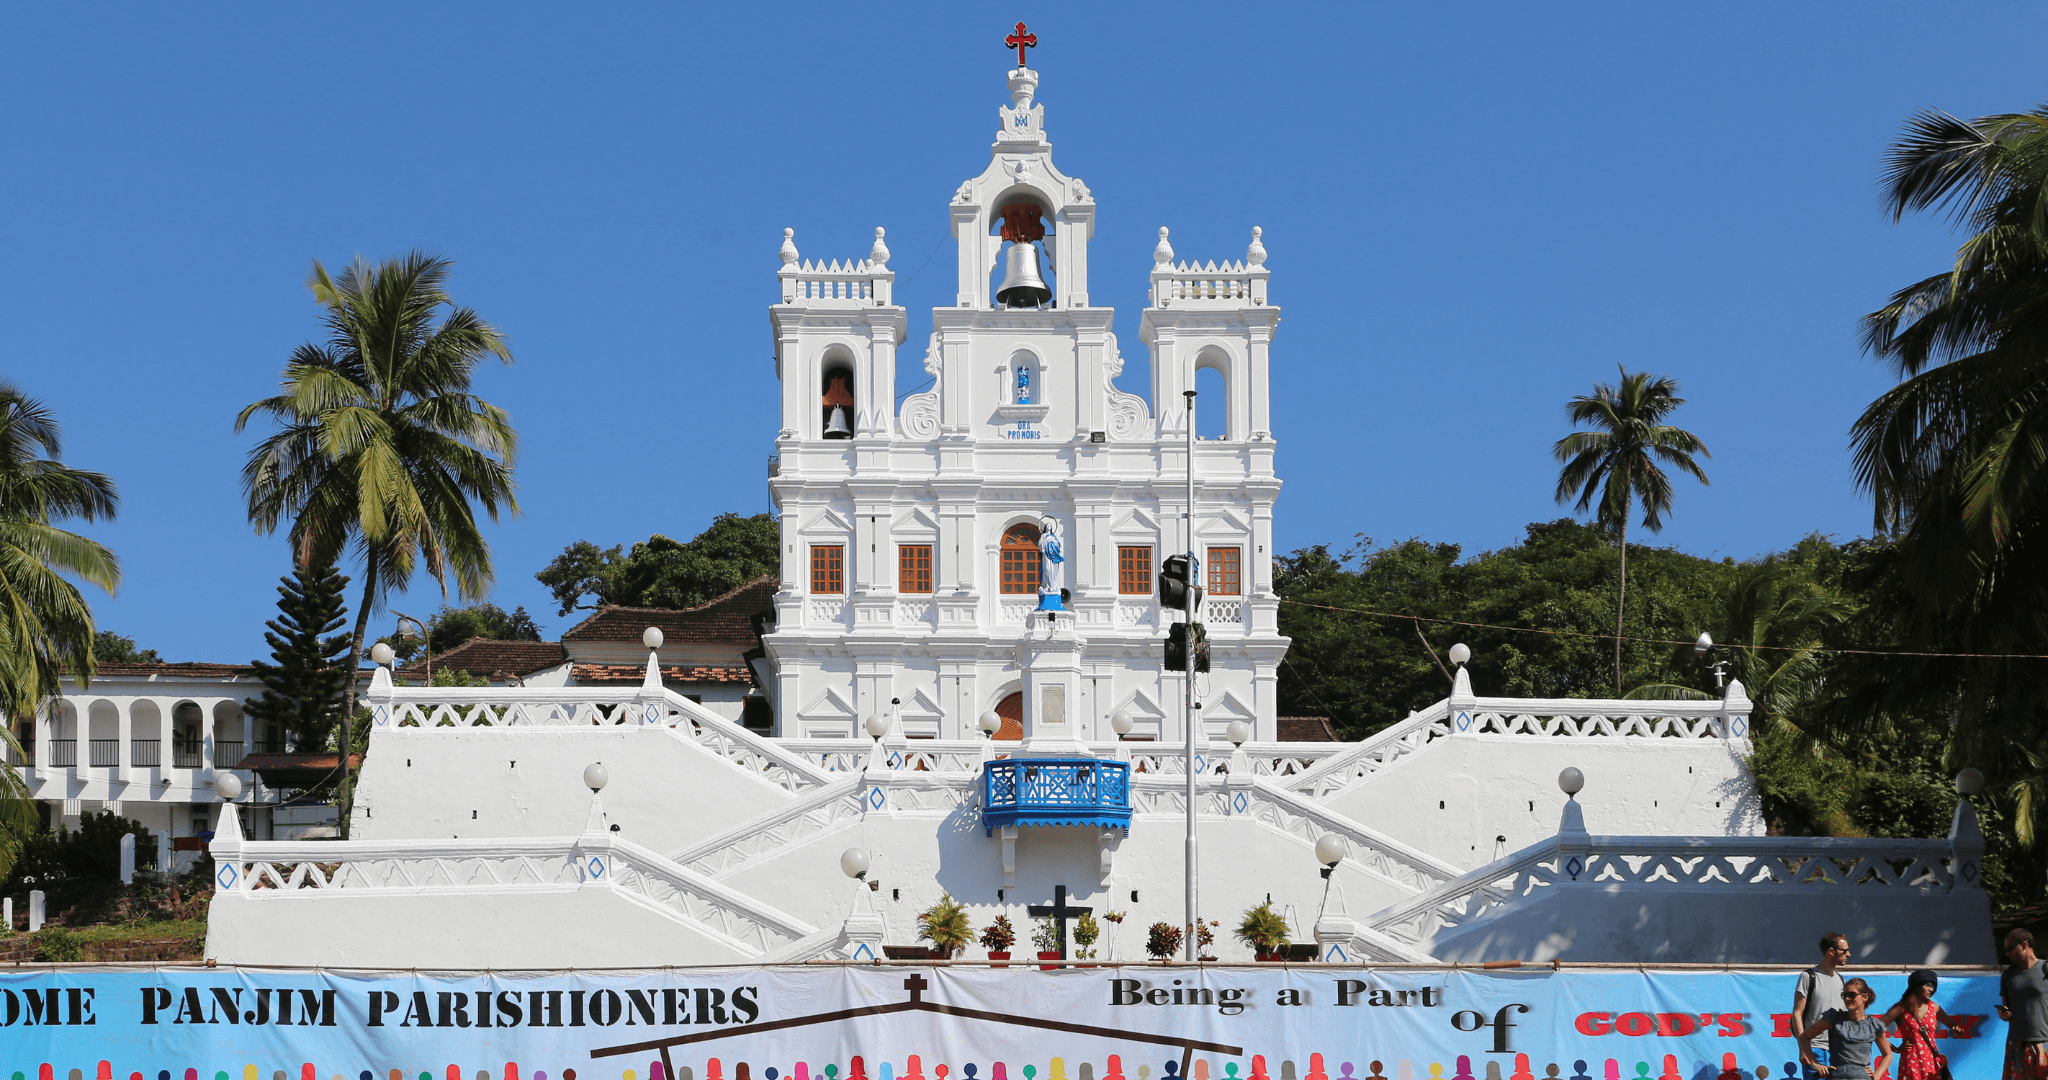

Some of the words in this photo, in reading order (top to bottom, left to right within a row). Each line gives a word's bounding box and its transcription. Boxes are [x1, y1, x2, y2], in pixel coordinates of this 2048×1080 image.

[1008, 430, 1021, 440] PRO
[1022, 430, 1041, 440] NOBIS
[1018, 420, 1031, 430] ORA
[140, 987, 337, 1027] PANJIM
[367, 986, 759, 1028] PARISHIONERS
[1108, 979, 1245, 1015] Being
[1277, 989, 1302, 1006] a
[1333, 980, 1437, 1007] Part
[1451, 1003, 1529, 1053] of
[1574, 1011, 1746, 1038] GOD'S
